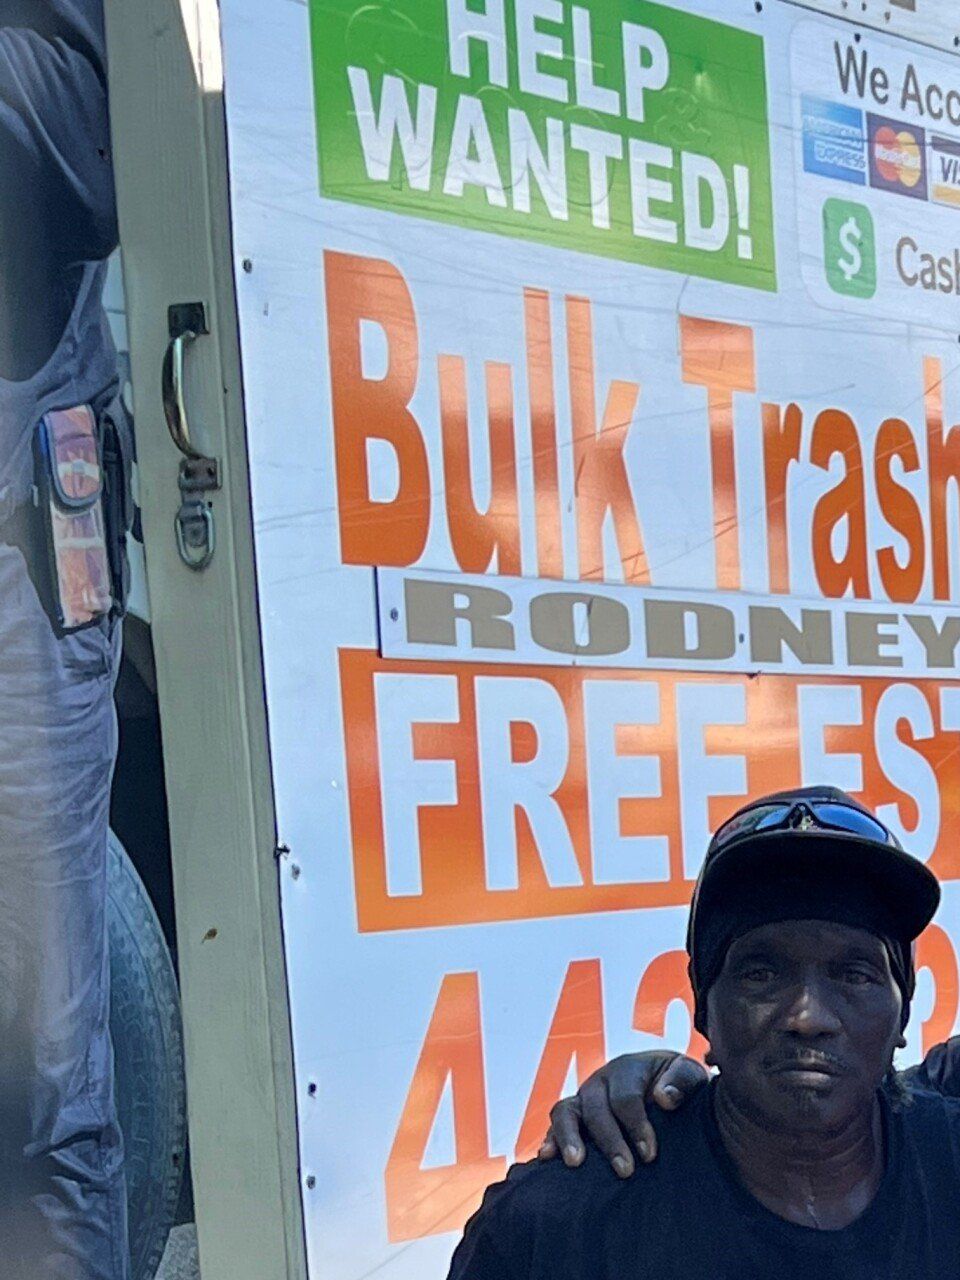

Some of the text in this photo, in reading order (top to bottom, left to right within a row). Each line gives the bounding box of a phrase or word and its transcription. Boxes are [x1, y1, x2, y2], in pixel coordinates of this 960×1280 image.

[446, 0, 670, 122] HELP
[833, 41, 890, 104] We
[347, 66, 753, 260] WANTED!
[323, 249, 652, 585] Bulk
[374, 672, 748, 897] FREE
